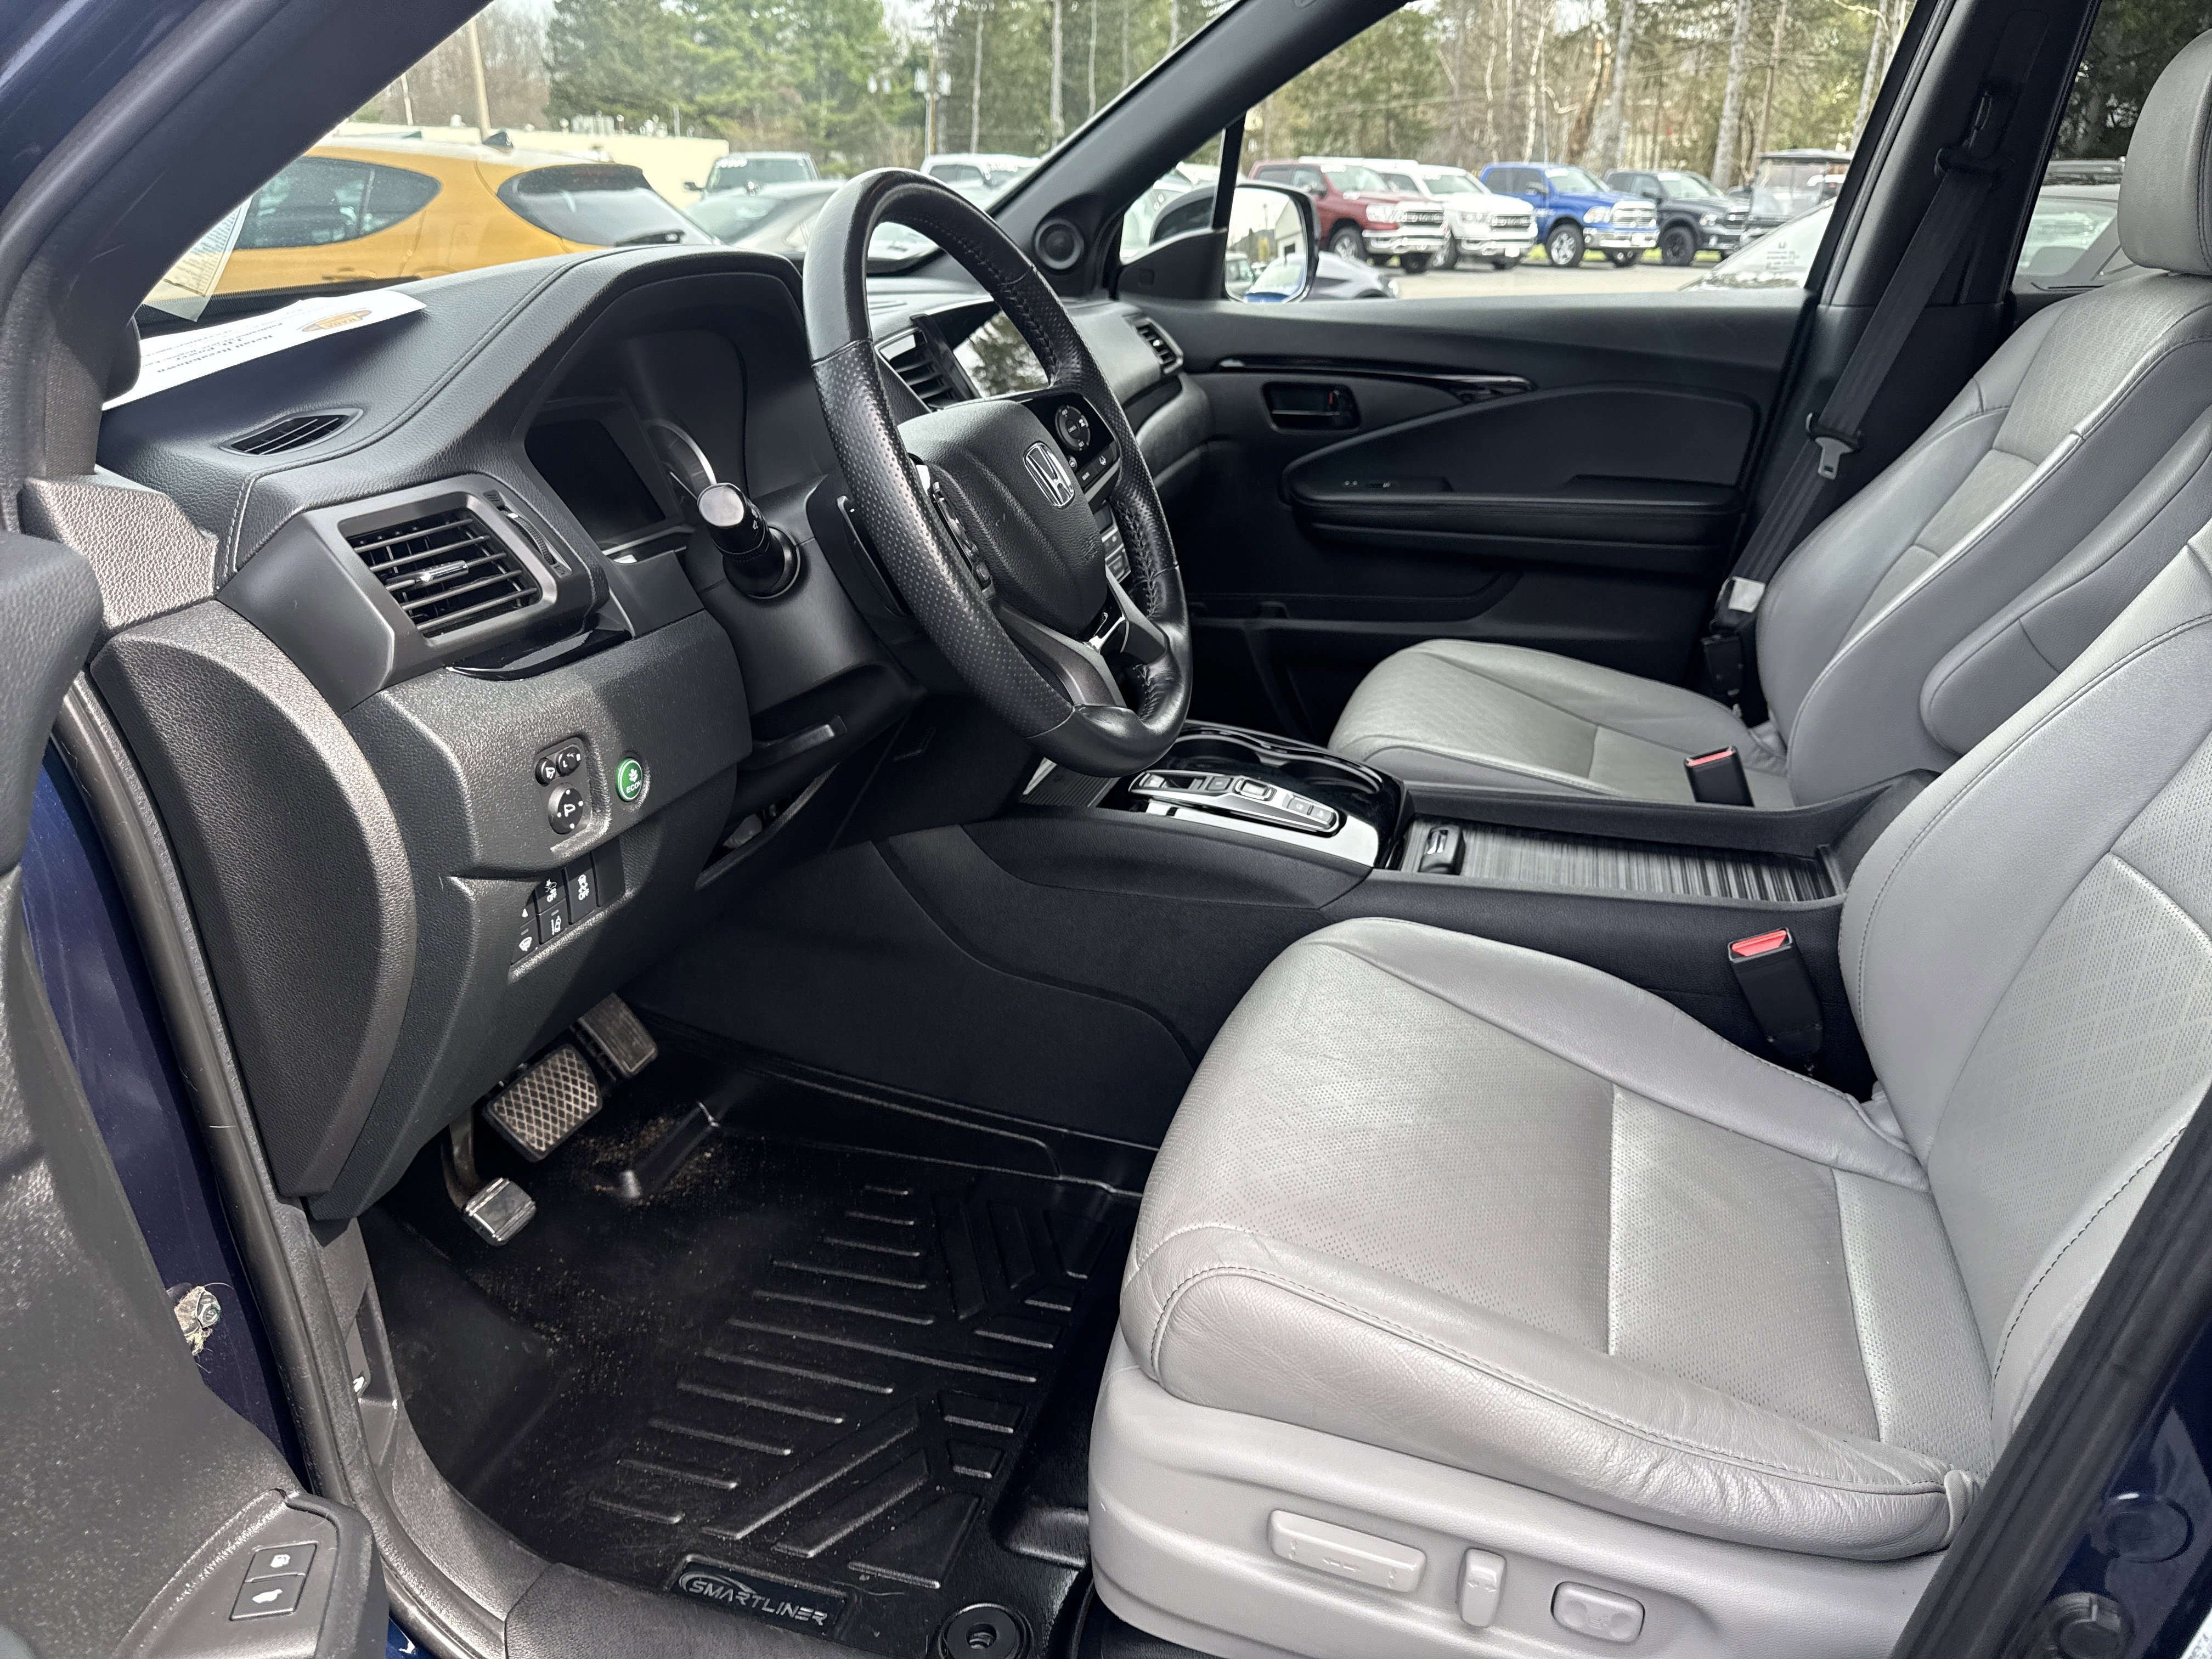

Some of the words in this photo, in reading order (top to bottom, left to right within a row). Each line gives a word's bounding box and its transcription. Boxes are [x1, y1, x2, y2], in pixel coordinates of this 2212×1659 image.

[234, 335, 273, 348] Retail
[156, 347, 232, 373] Breakdown
[626, 780, 641, 793] ECON
[546, 891, 557, 902] OFF
[578, 888, 589, 900] OFF
[689, 1580, 828, 1626] SMARTLINER
